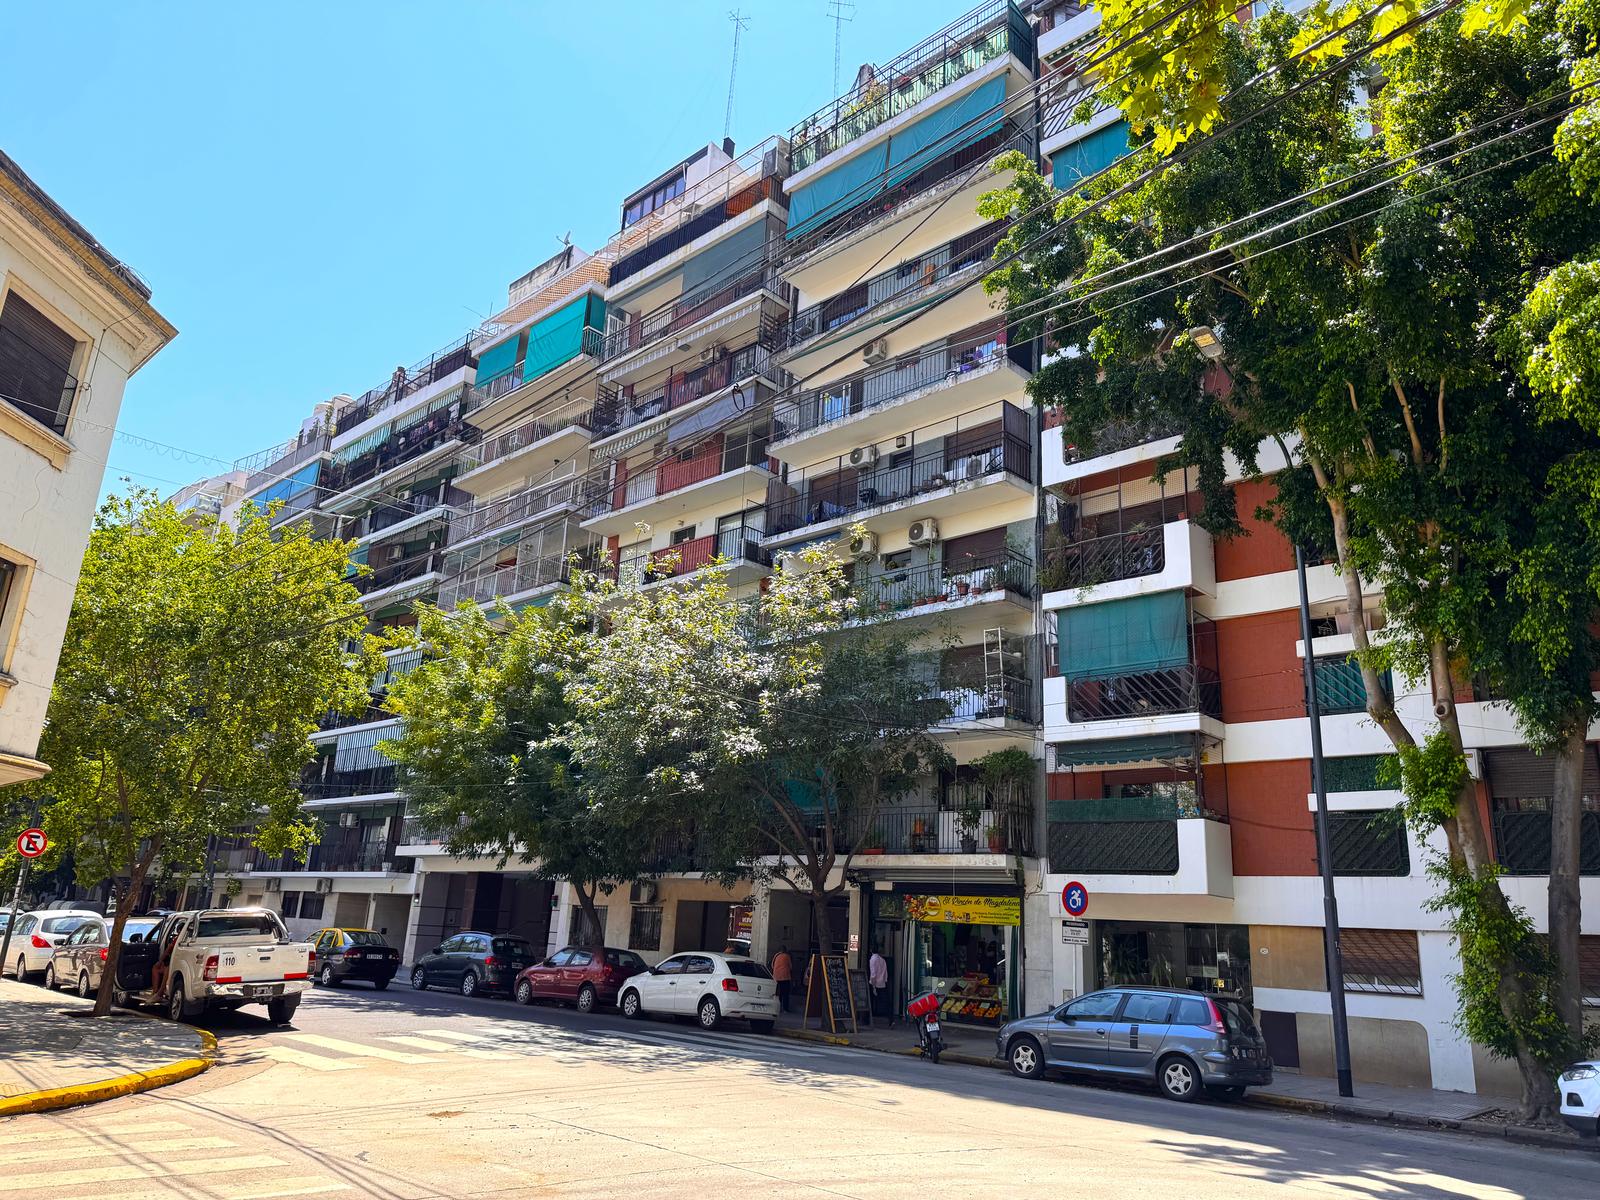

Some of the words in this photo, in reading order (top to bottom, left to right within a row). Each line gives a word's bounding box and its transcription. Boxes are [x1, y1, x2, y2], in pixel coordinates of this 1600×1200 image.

[25, 834, 41, 851] E
[942, 896, 950, 905] El
[984, 897, 1020, 908] Magdalena
[225, 956, 236, 966] 110
